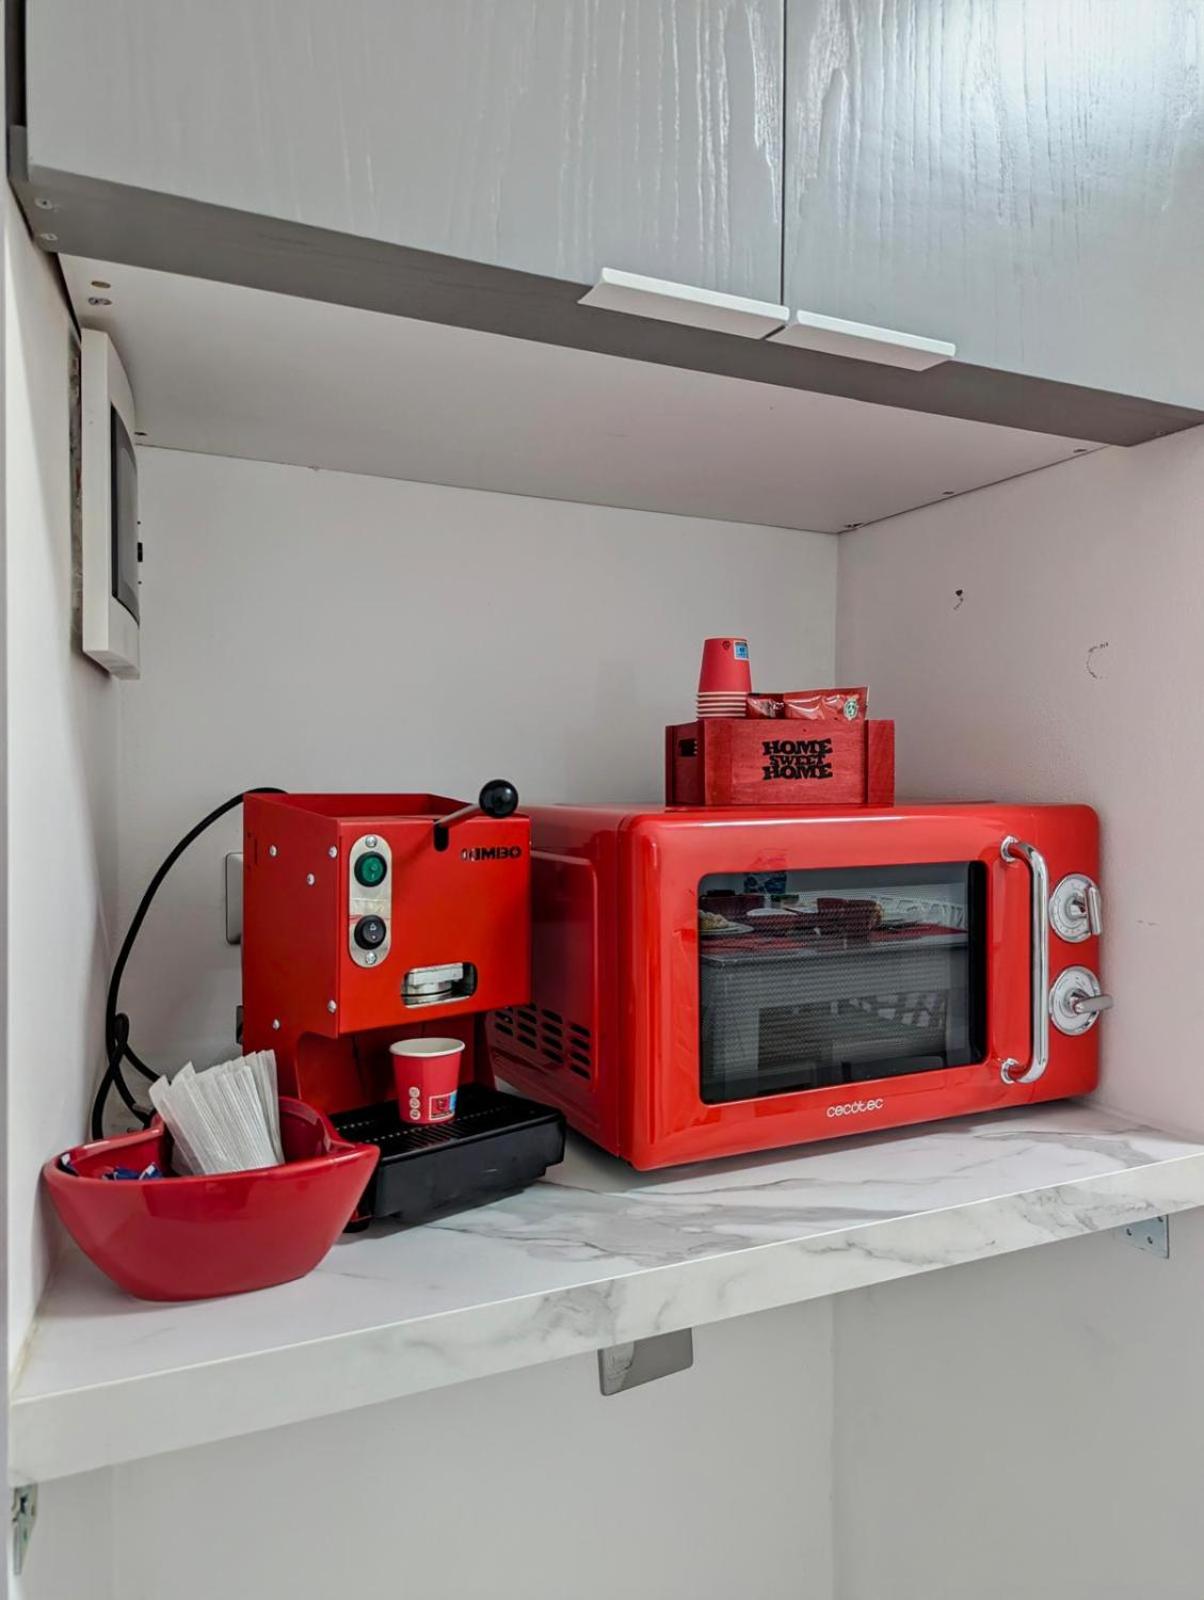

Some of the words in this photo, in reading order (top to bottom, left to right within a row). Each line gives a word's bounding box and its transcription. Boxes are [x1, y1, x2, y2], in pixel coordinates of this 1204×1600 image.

[762, 738, 833, 755] HOME
[769, 754, 826, 767] SWEET
[762, 763, 833, 780] HOME
[826, 1098, 884, 1117] cecotec
